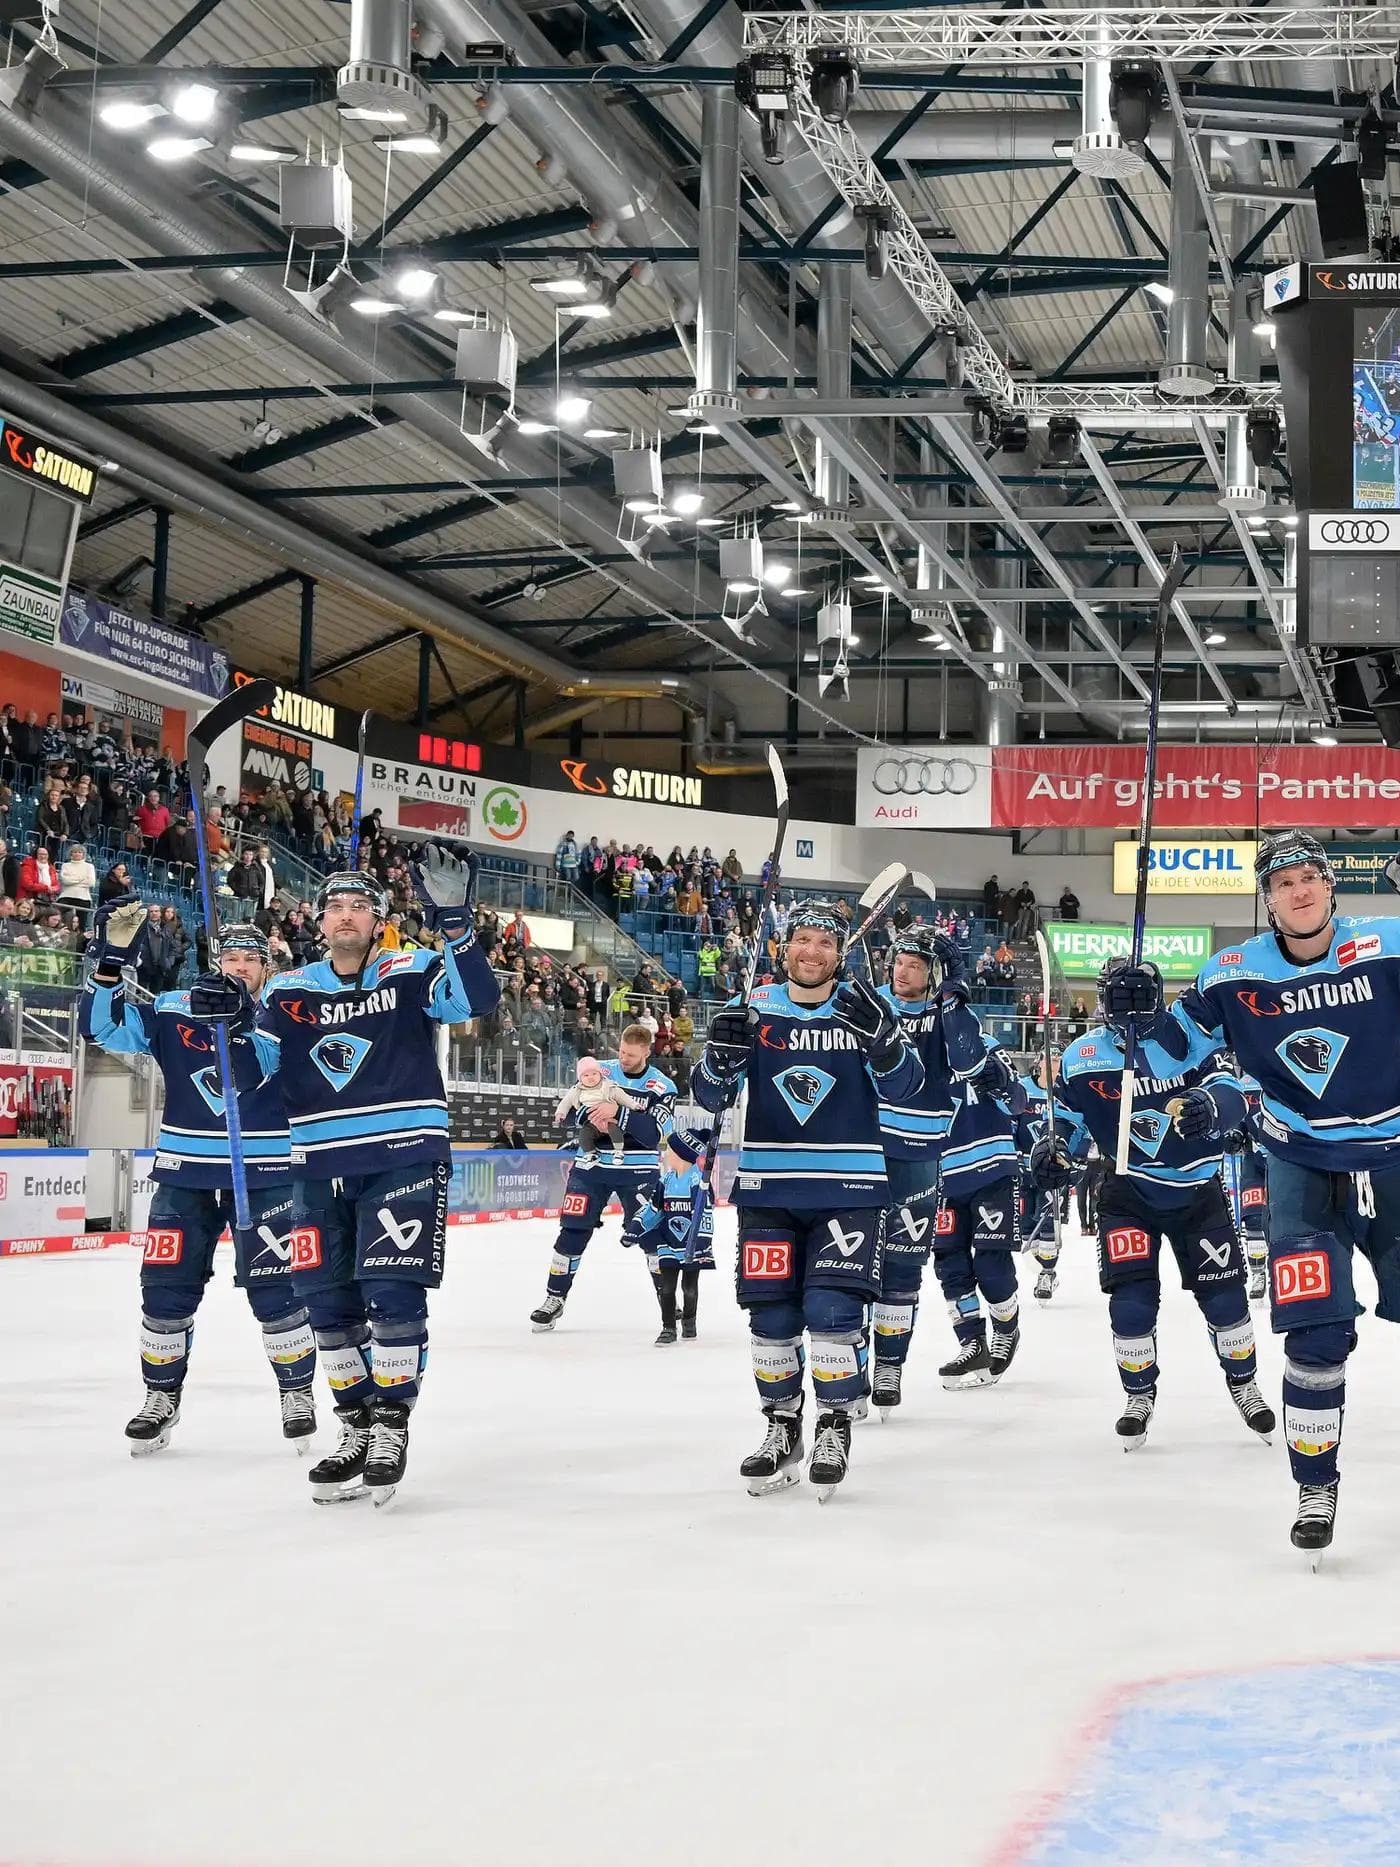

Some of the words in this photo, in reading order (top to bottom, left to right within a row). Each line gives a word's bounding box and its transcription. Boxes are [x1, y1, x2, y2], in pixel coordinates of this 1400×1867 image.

[33, 446, 93, 496] SATURN
[3, 589, 58, 623] ZAUNBAU
[108, 610, 133, 630] JETZT
[133, 617, 190, 651] VIP-UPGRADE
[111, 629, 131, 645] NUR
[131, 636, 143, 651] 64
[143, 641, 169, 660] EURO
[271, 686, 335, 739] SATURN
[242, 748, 290, 784] MVA
[371, 763, 476, 797] BRAUN
[612, 767, 702, 806] SATURN
[1026, 773, 1103, 800] Auf
[370, 781, 408, 794] sicher
[416, 789, 476, 807] entsorgen
[874, 806, 918, 818] Audi
[798, 841, 812, 857] M
[1136, 848, 1243, 871] BÜCHL
[1165, 876, 1196, 889] IDEE
[1200, 876, 1243, 889] VORAUS
[319, 987, 397, 1024] SATURN
[1280, 975, 1374, 1014] SATURN
[1081, 1047, 1095, 1056] DB
[384, 1177, 435, 1202] BAUER
[262, 1199, 294, 1220] BAUE
[432, 1161, 449, 1273] partyrent.co
[9, 1240, 46, 1254] PENNY.
[72, 1235, 105, 1249] PENNY.
[871, 1209, 888, 1281] partyren
[885, 1243, 927, 1253] BAUER
[1113, 1231, 1146, 1257] DB
[249, 1265, 293, 1278] BAUE
[363, 1255, 425, 1268] BAUER
[748, 1247, 786, 1272] DB
[815, 1259, 864, 1272] BAUER
[1198, 1268, 1239, 1281] BAUER
[1278, 1257, 1322, 1297] DB
